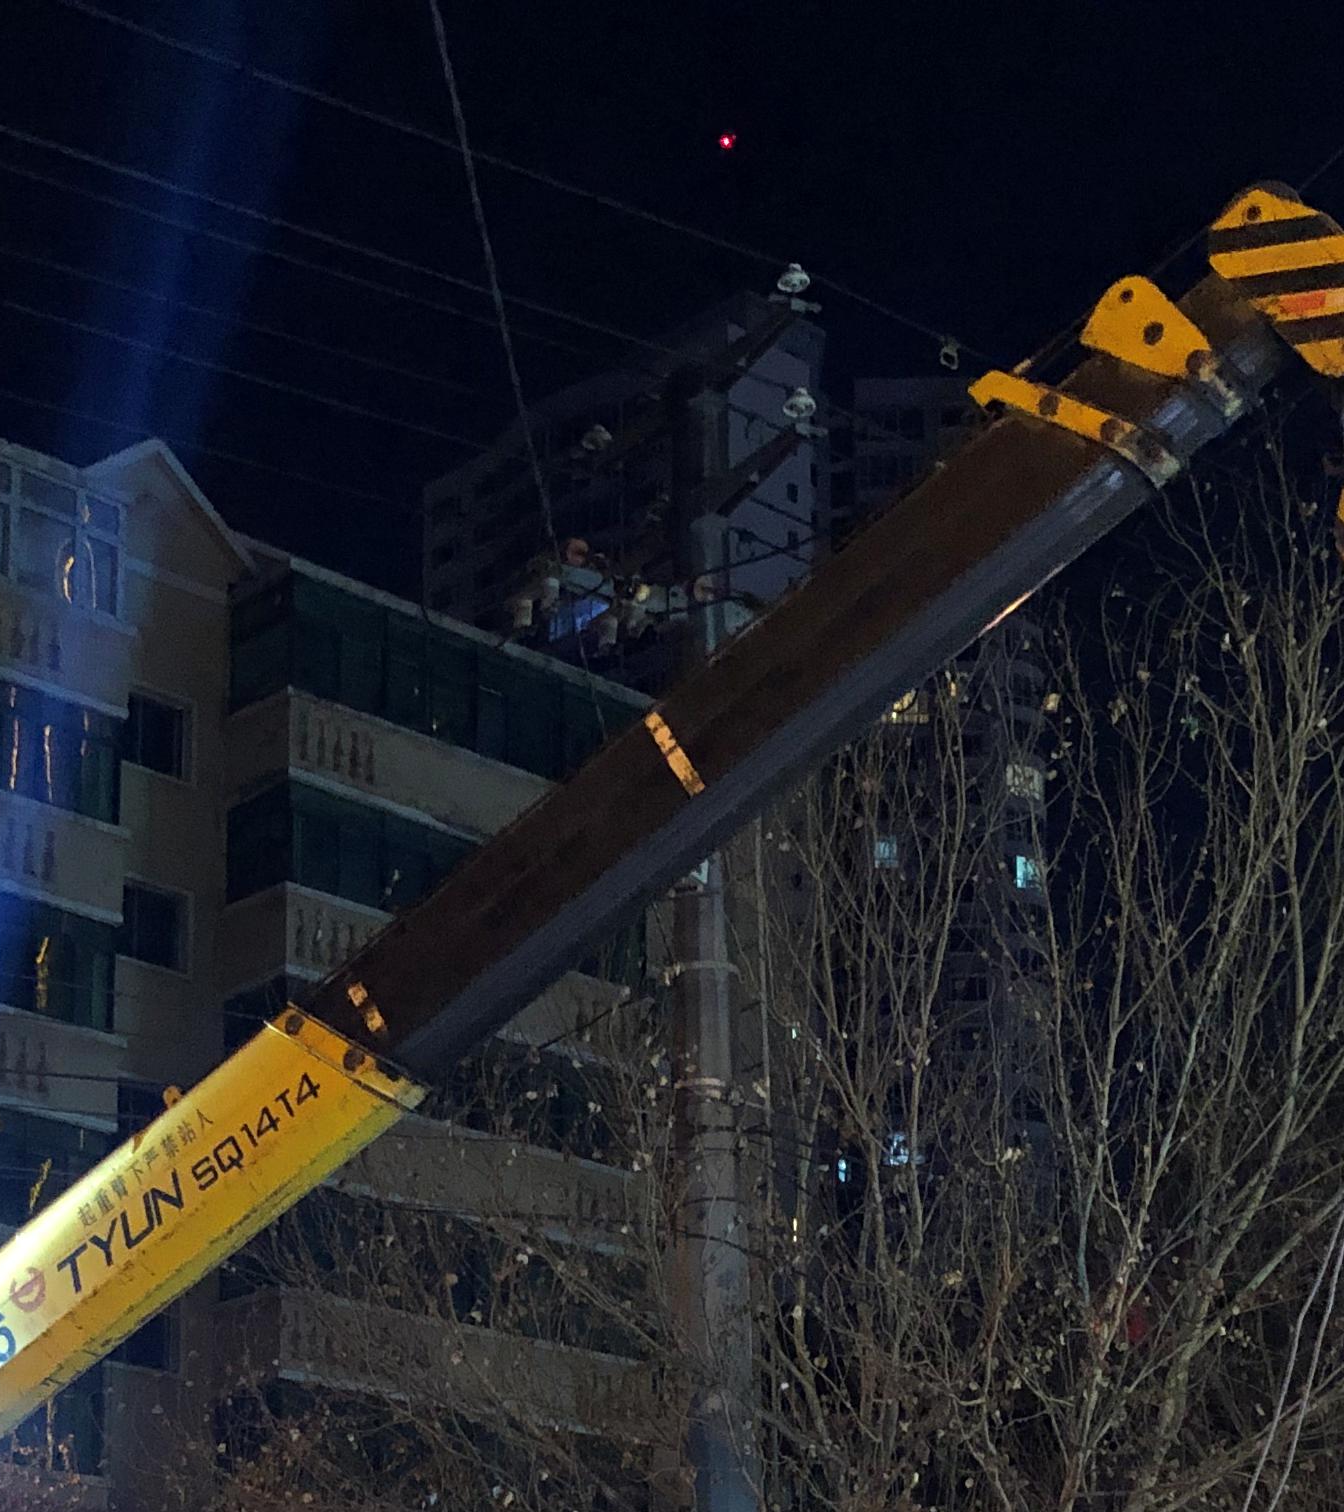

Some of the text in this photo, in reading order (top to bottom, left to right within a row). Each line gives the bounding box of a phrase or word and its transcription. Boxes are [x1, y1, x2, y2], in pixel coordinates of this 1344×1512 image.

[57, 1072, 320, 1293] TYUN SQ14T4
[77, 1107, 214, 1228] 起重臂下严禁站人
